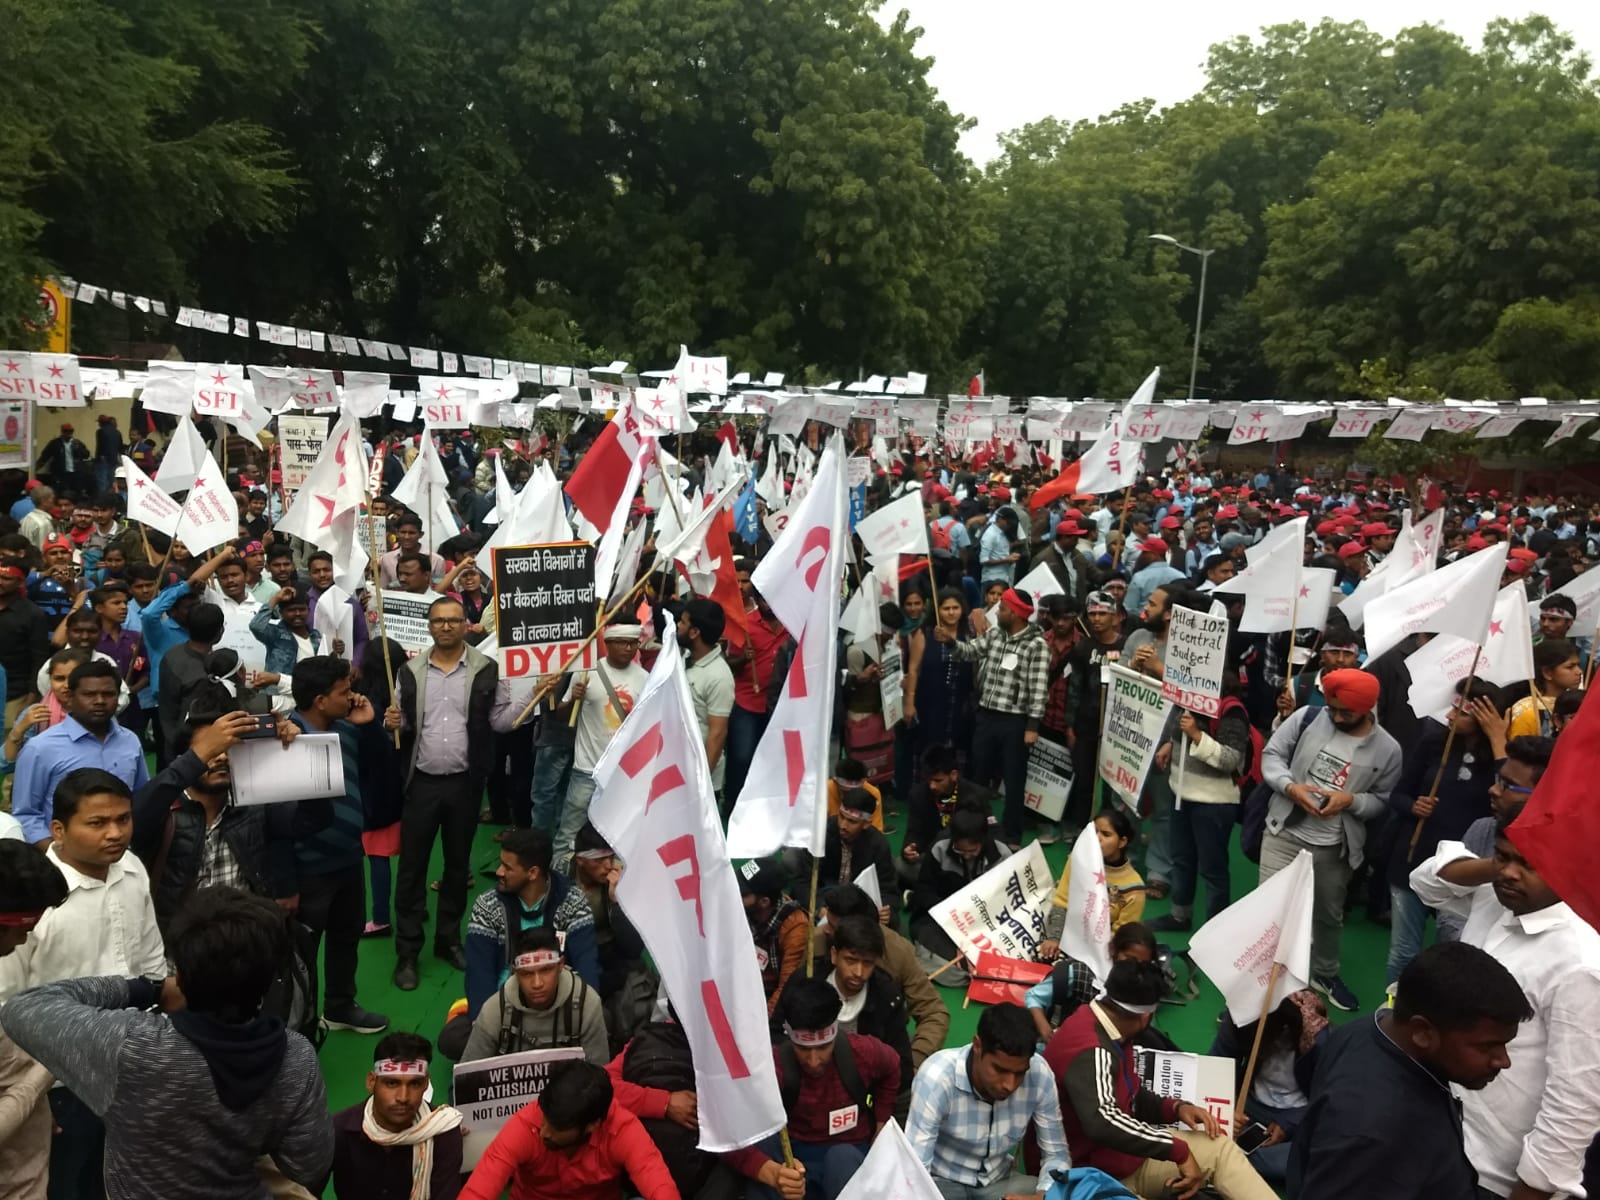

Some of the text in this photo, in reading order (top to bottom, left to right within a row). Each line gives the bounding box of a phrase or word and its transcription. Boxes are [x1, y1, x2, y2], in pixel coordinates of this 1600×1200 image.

[0, 377, 37, 395] SFI
[39, 382, 78, 401] SFI
[197, 390, 238, 411] SFI
[294, 390, 333, 405] SFI
[426, 404, 463, 423] SFI
[857, 407, 890, 416] SFI
[949, 413, 981, 424] SF
[878, 427, 898, 436] SFI
[1127, 423, 1162, 438] SFI
[1233, 426, 1269, 441] SFI
[1335, 420, 1370, 433] SFI
[505, 548, 587, 575] सरकारी विभागों में
[499, 592, 512, 610] ST
[553, 584, 575, 606] रिक्त
[577, 581, 595, 603] पदों
[512, 616, 583, 642] को तत्काल भरो!
[1172, 609, 1225, 633] Allot 10%
[1170, 625, 1178, 641] of
[505, 641, 592, 678] DYFI
[1171, 645, 1210, 667] Budget
[1165, 663, 1220, 693] EDUCATION
[1180, 664, 1191, 675] on
[1114, 677, 1165, 711] PROVIDE
[1181, 690, 1219, 715] DSO
[1116, 765, 1138, 794] DSO
[961, 910, 976, 926] All
[519, 953, 553, 966] SFI
[799, 1027, 835, 1041] SFI
[383, 1060, 424, 1073] SFI
[489, 1062, 551, 1083] WE WANT
[477, 1078, 551, 1101] PATHSHAA
[472, 1107, 493, 1121] NOT
[831, 1111, 856, 1129] SFI
